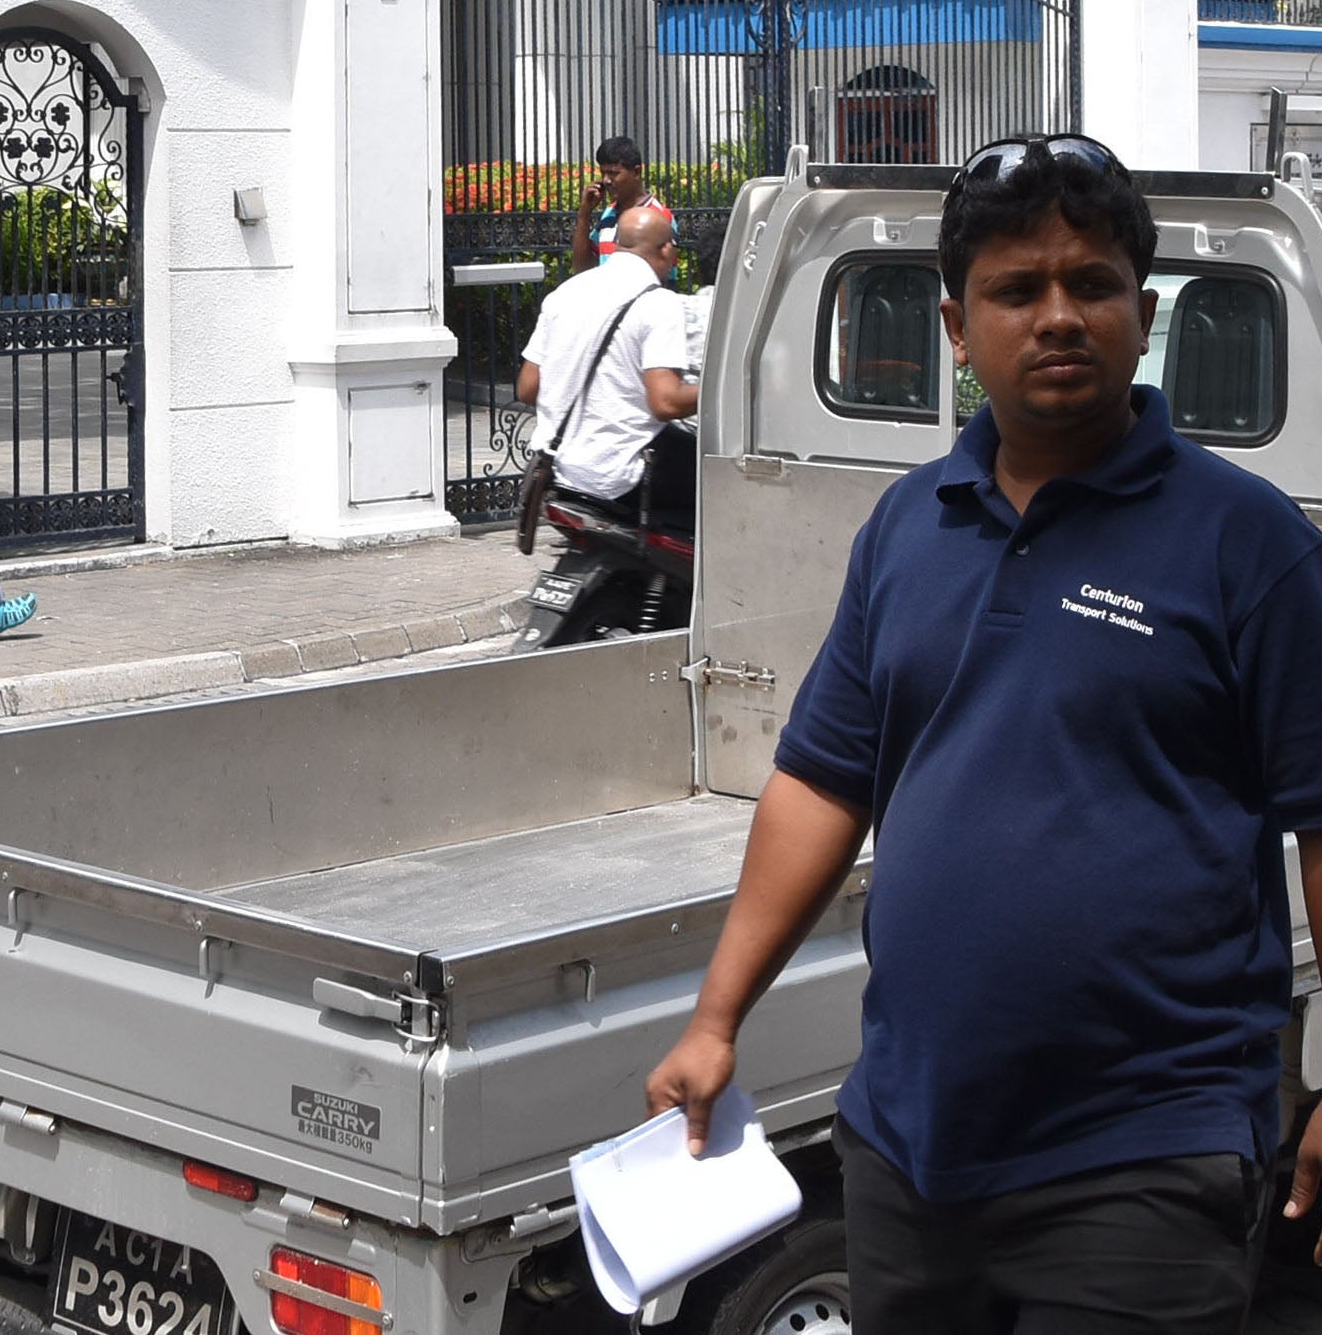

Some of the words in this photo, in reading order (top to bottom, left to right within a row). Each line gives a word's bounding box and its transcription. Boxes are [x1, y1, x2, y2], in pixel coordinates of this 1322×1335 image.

[1080, 583, 1144, 614] Centurion
[1061, 597, 1107, 621] Transport
[1108, 612, 1154, 636] Solutions
[297, 1101, 375, 1136] CARRY
[313, 1093, 359, 1115] SUZUKI
